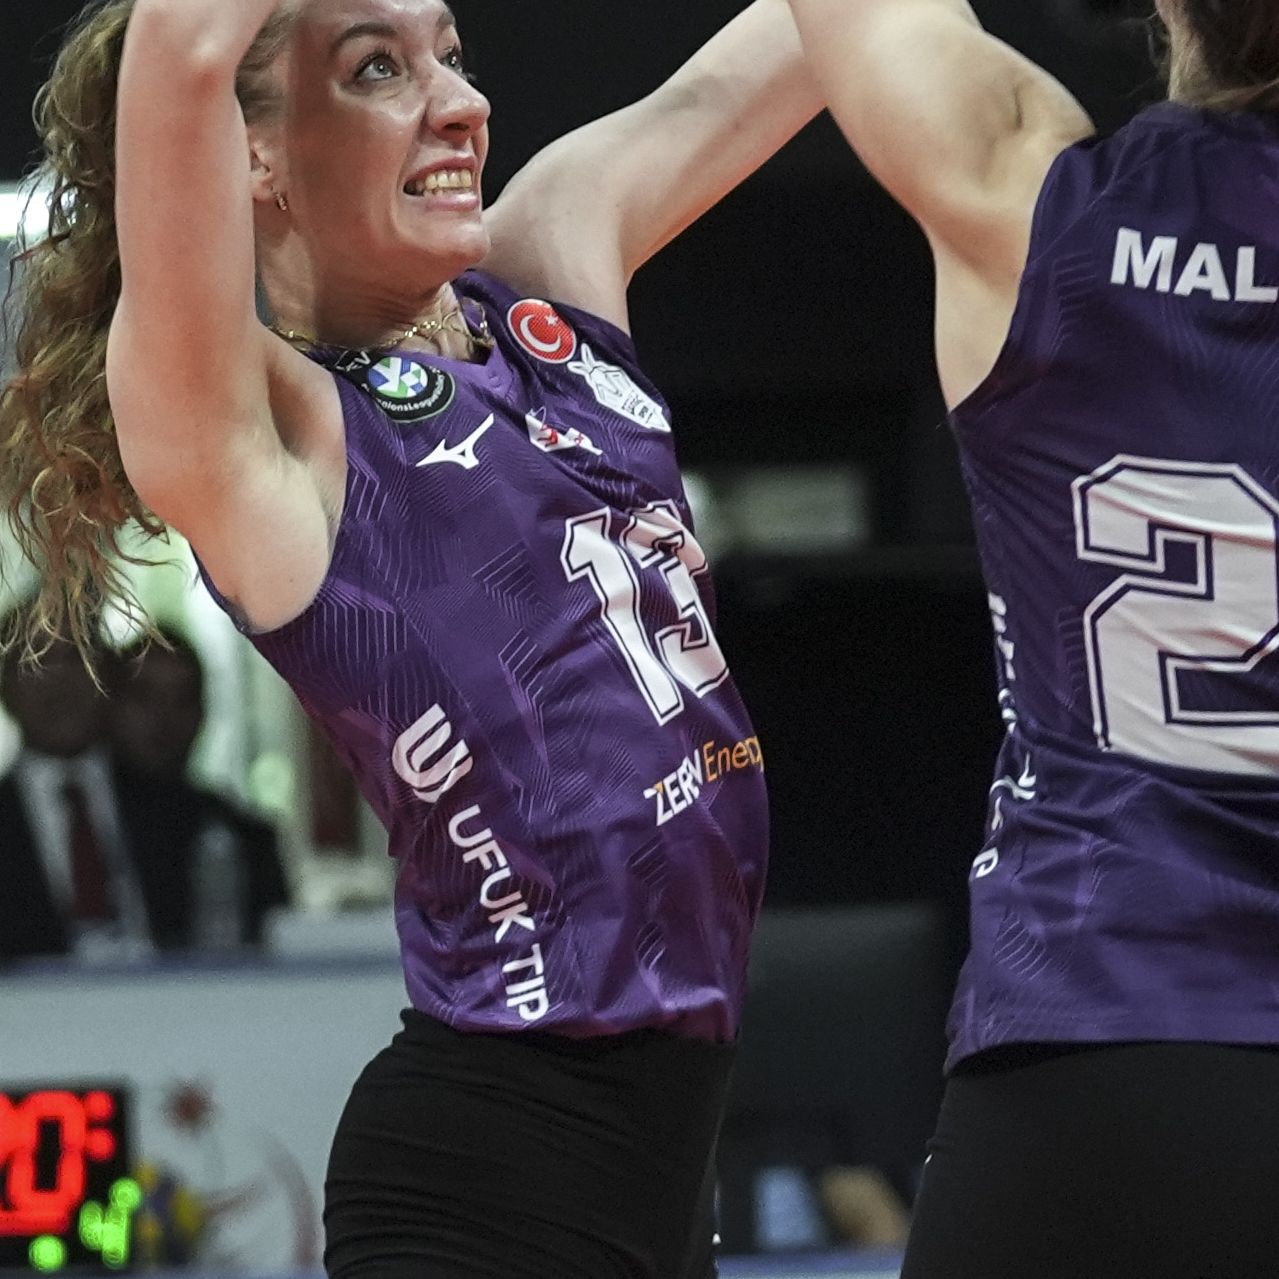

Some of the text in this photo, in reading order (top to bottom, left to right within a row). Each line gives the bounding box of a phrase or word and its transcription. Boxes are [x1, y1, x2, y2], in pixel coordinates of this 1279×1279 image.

[559, 498, 730, 727] 13
[447, 804, 550, 1022] UFUK TIP
